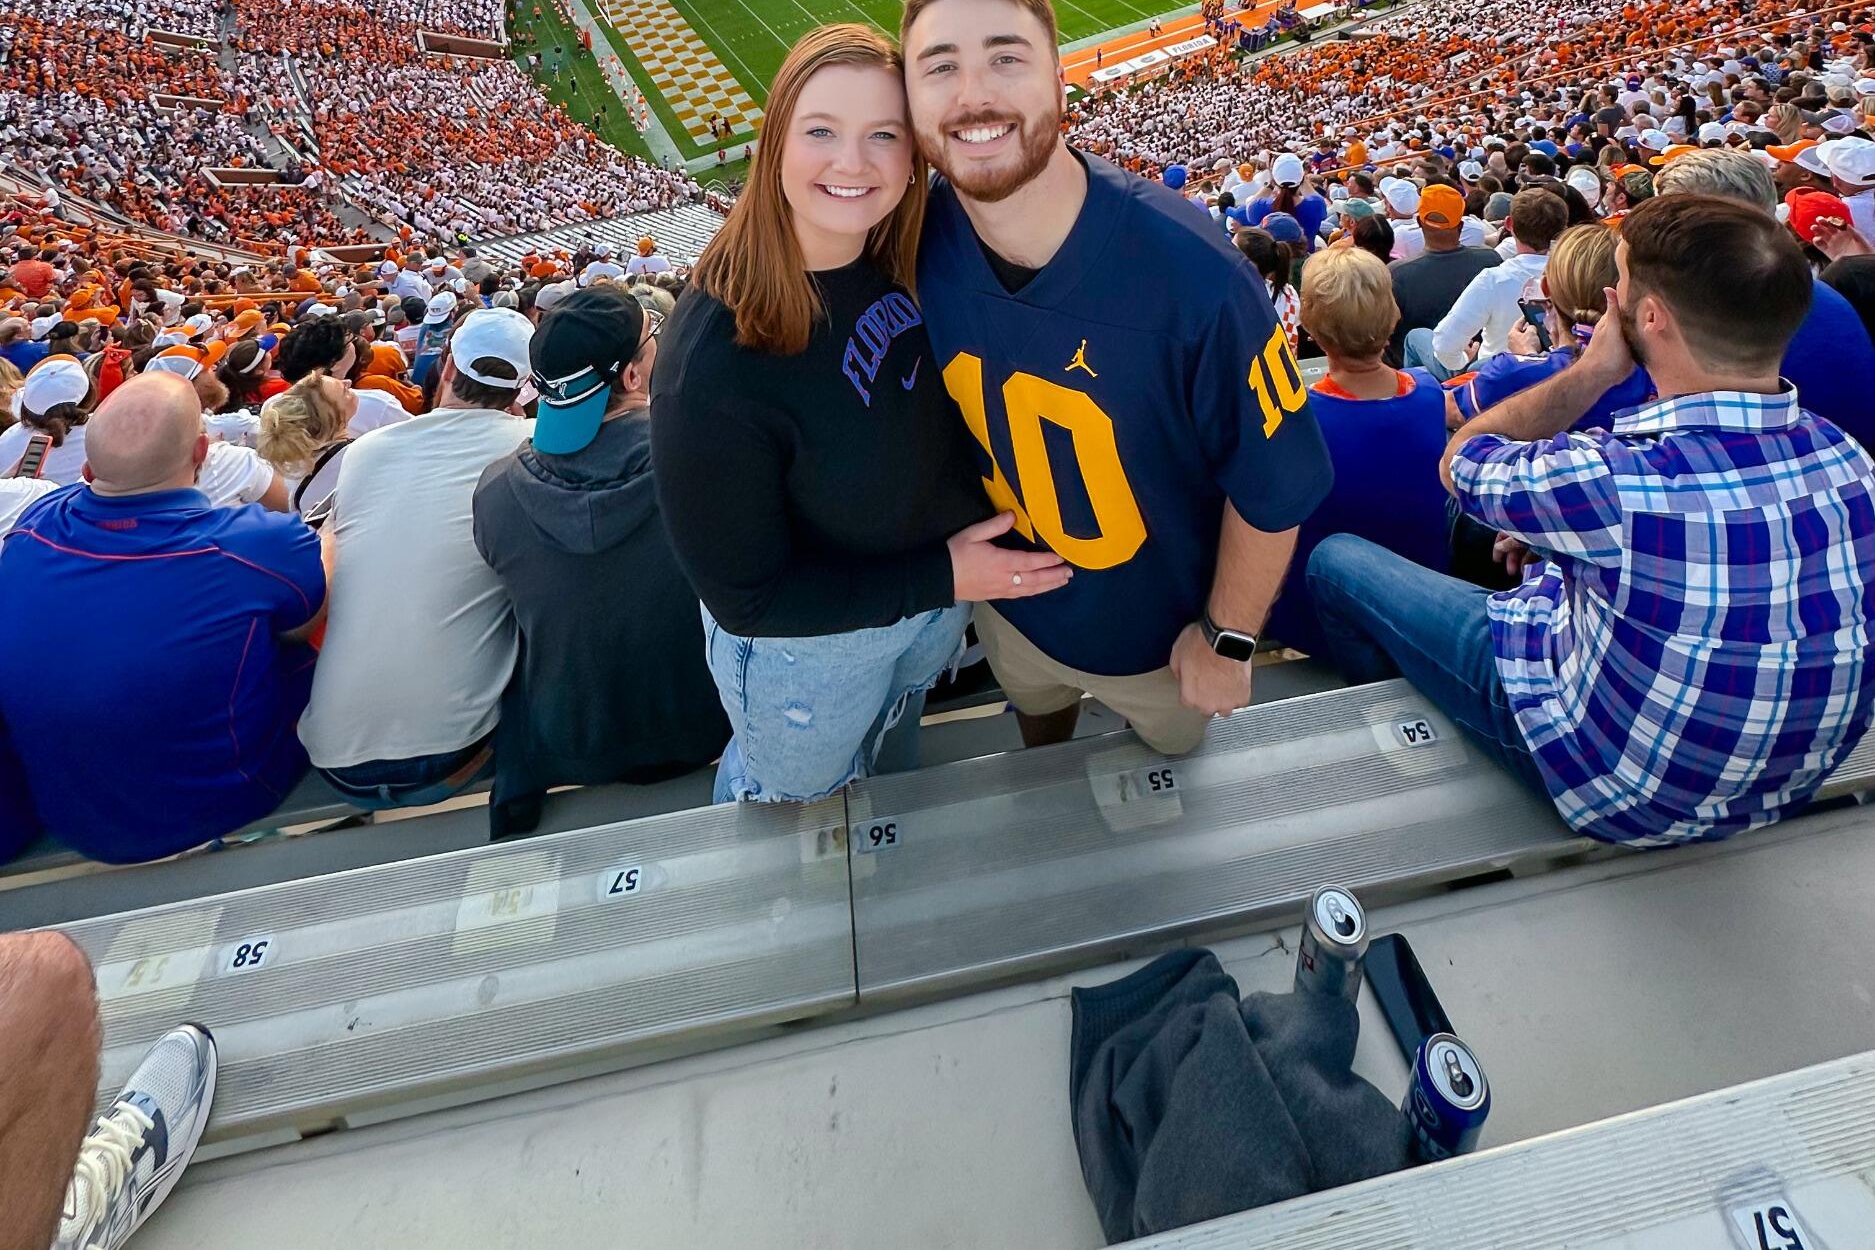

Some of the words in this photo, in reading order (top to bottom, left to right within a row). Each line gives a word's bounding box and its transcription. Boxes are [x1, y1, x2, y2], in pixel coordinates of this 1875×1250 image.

[1171, 37, 1211, 54] FLORIDA
[1247, 322, 1308, 439] 10
[941, 351, 1148, 570] 10
[1402, 721, 1431, 743] 54
[1147, 768, 1175, 792] 55
[869, 822, 897, 847] 56
[608, 869, 639, 895] 57
[232, 941, 268, 968] 58
